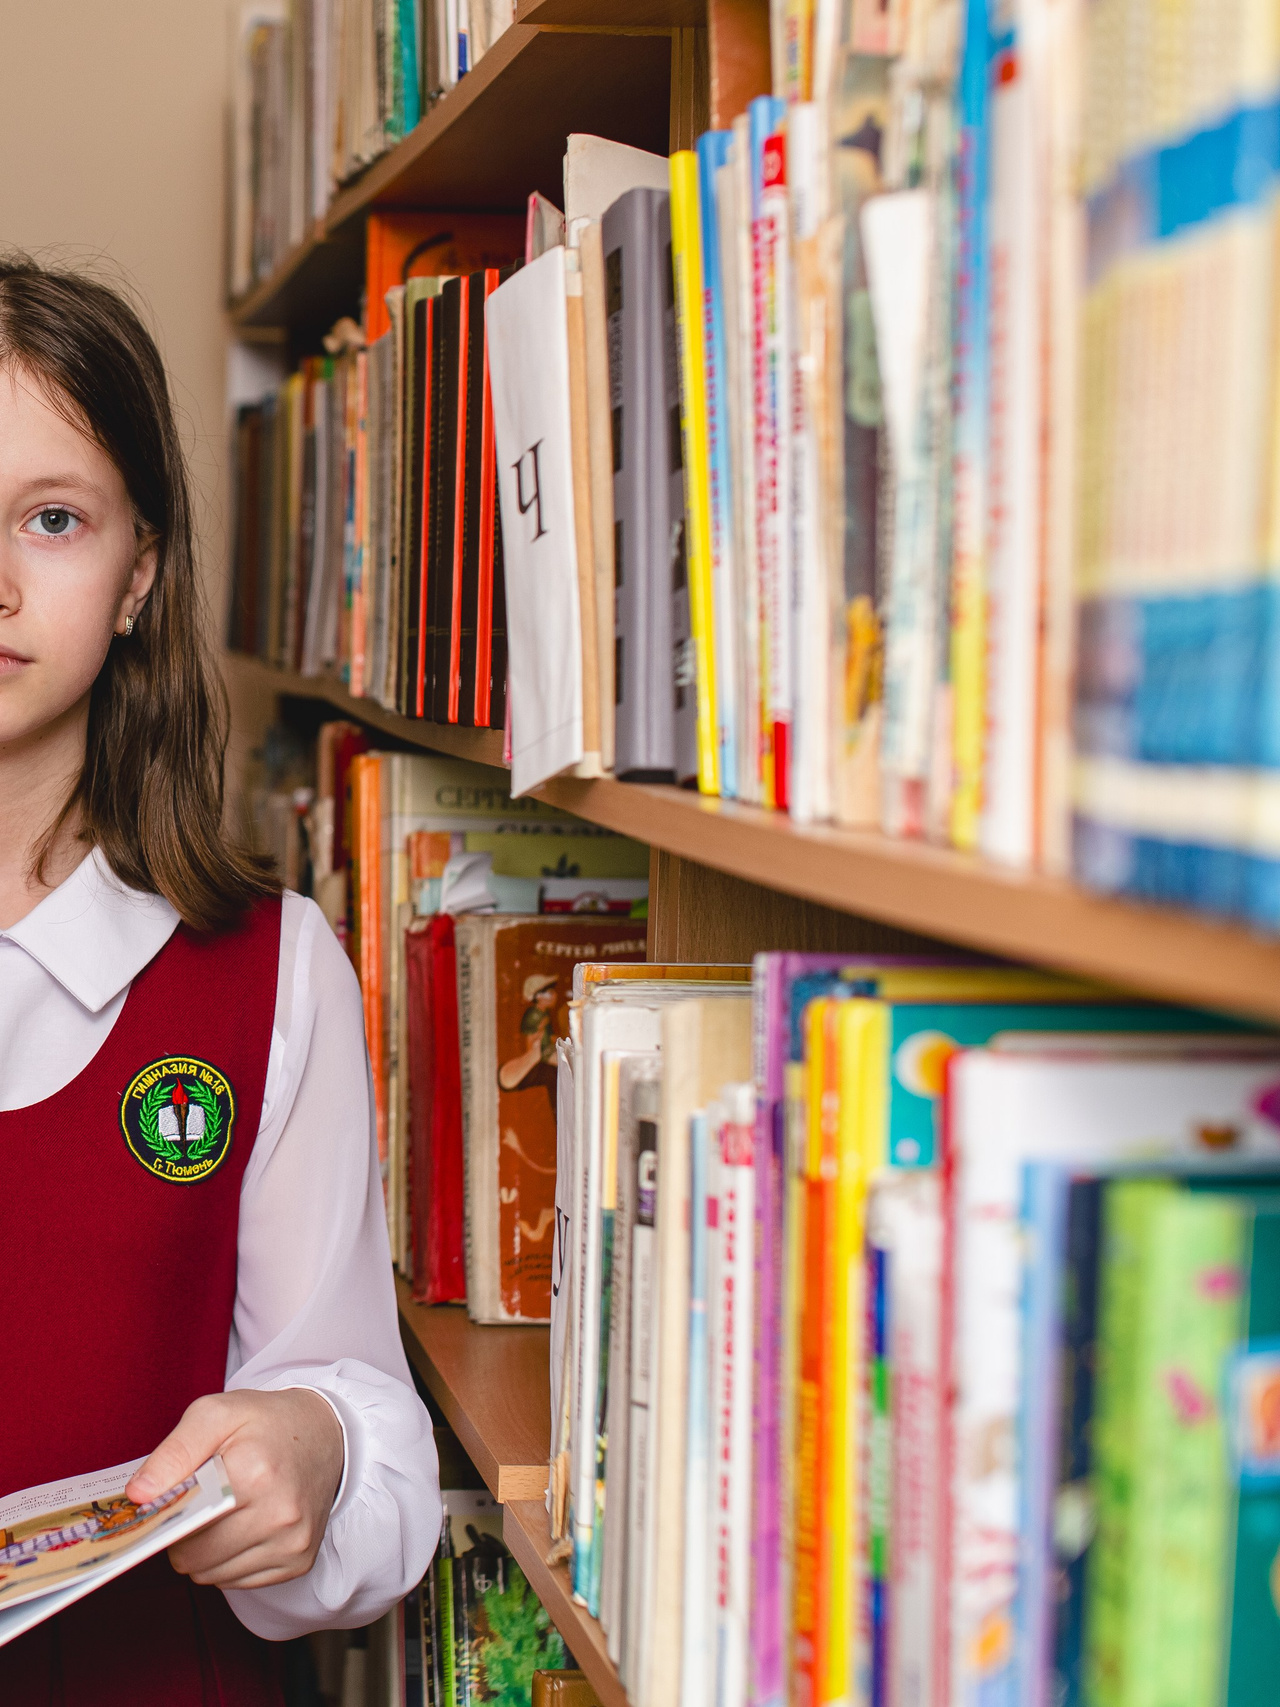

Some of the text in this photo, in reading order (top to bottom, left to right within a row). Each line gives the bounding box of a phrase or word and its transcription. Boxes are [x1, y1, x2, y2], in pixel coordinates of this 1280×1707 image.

[510, 438, 549, 543] Ч
[535, 940, 596, 958] СЕРГЕЙ
[133, 1062, 225, 1099] ГИМНАЗИЯ №16
[165, 1158, 214, 1177] Тюмень
[554, 1206, 569, 1297] У
